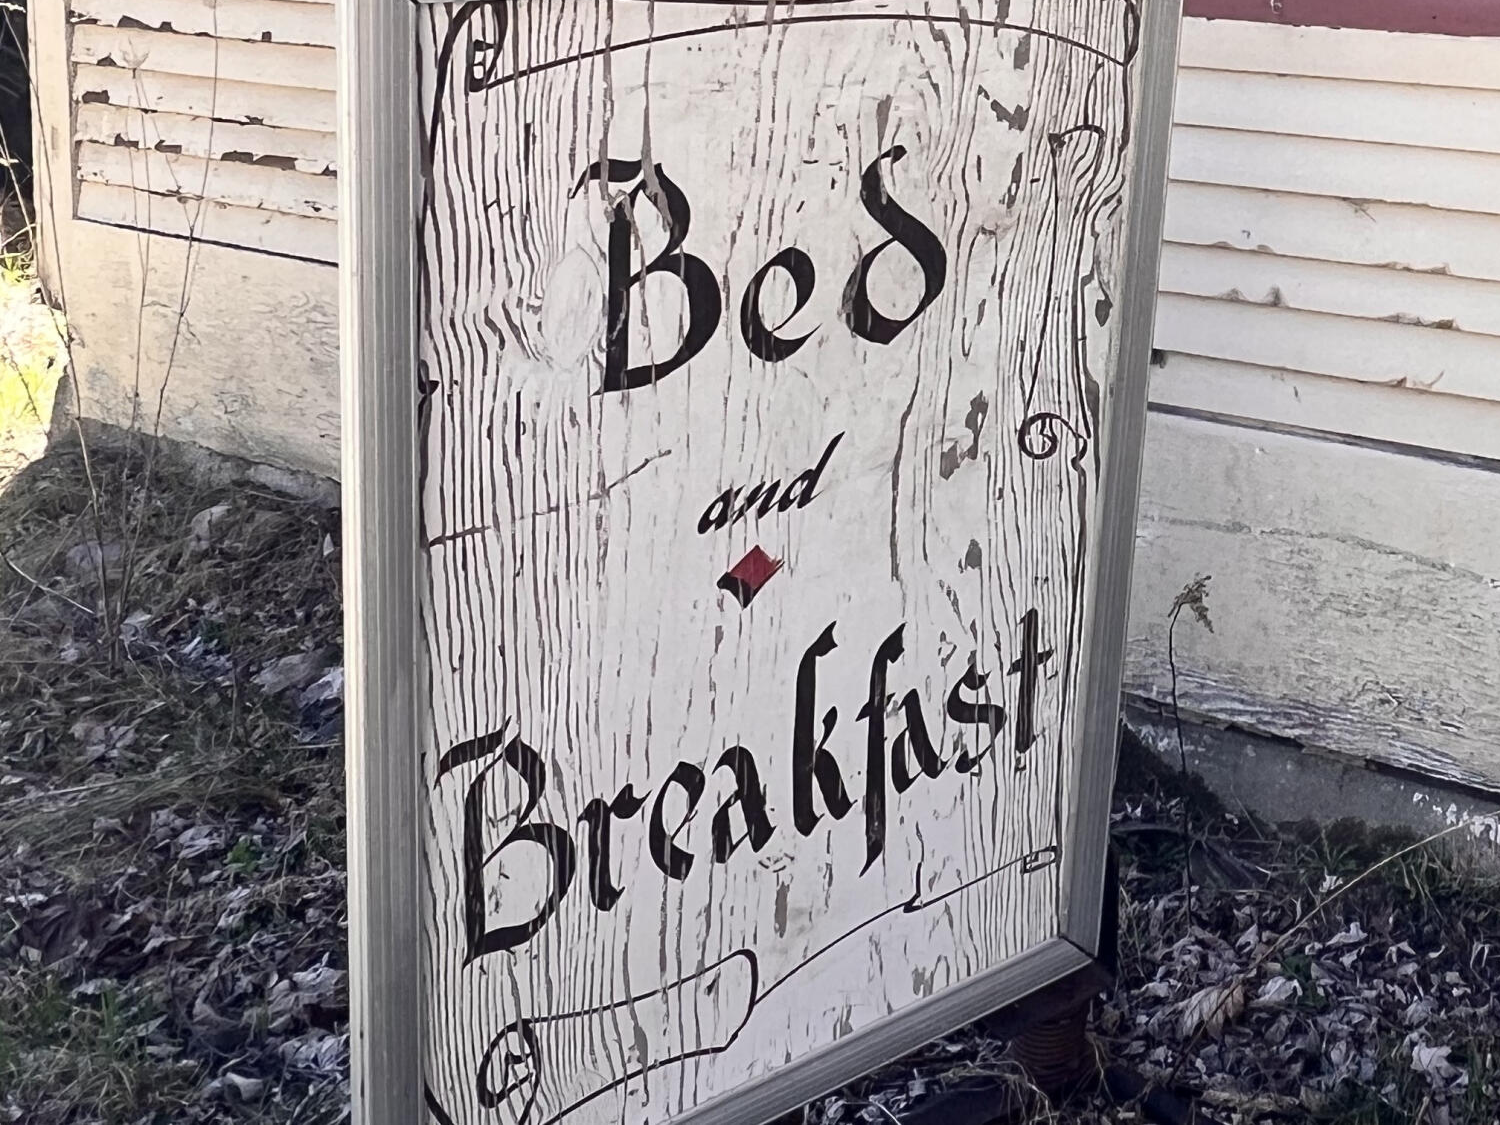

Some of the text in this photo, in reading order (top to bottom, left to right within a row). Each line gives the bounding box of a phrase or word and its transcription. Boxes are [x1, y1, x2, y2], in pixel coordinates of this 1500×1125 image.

[570, 145, 948, 395] Bed
[696, 432, 844, 537] and
[434, 608, 1054, 965] Breakfast
